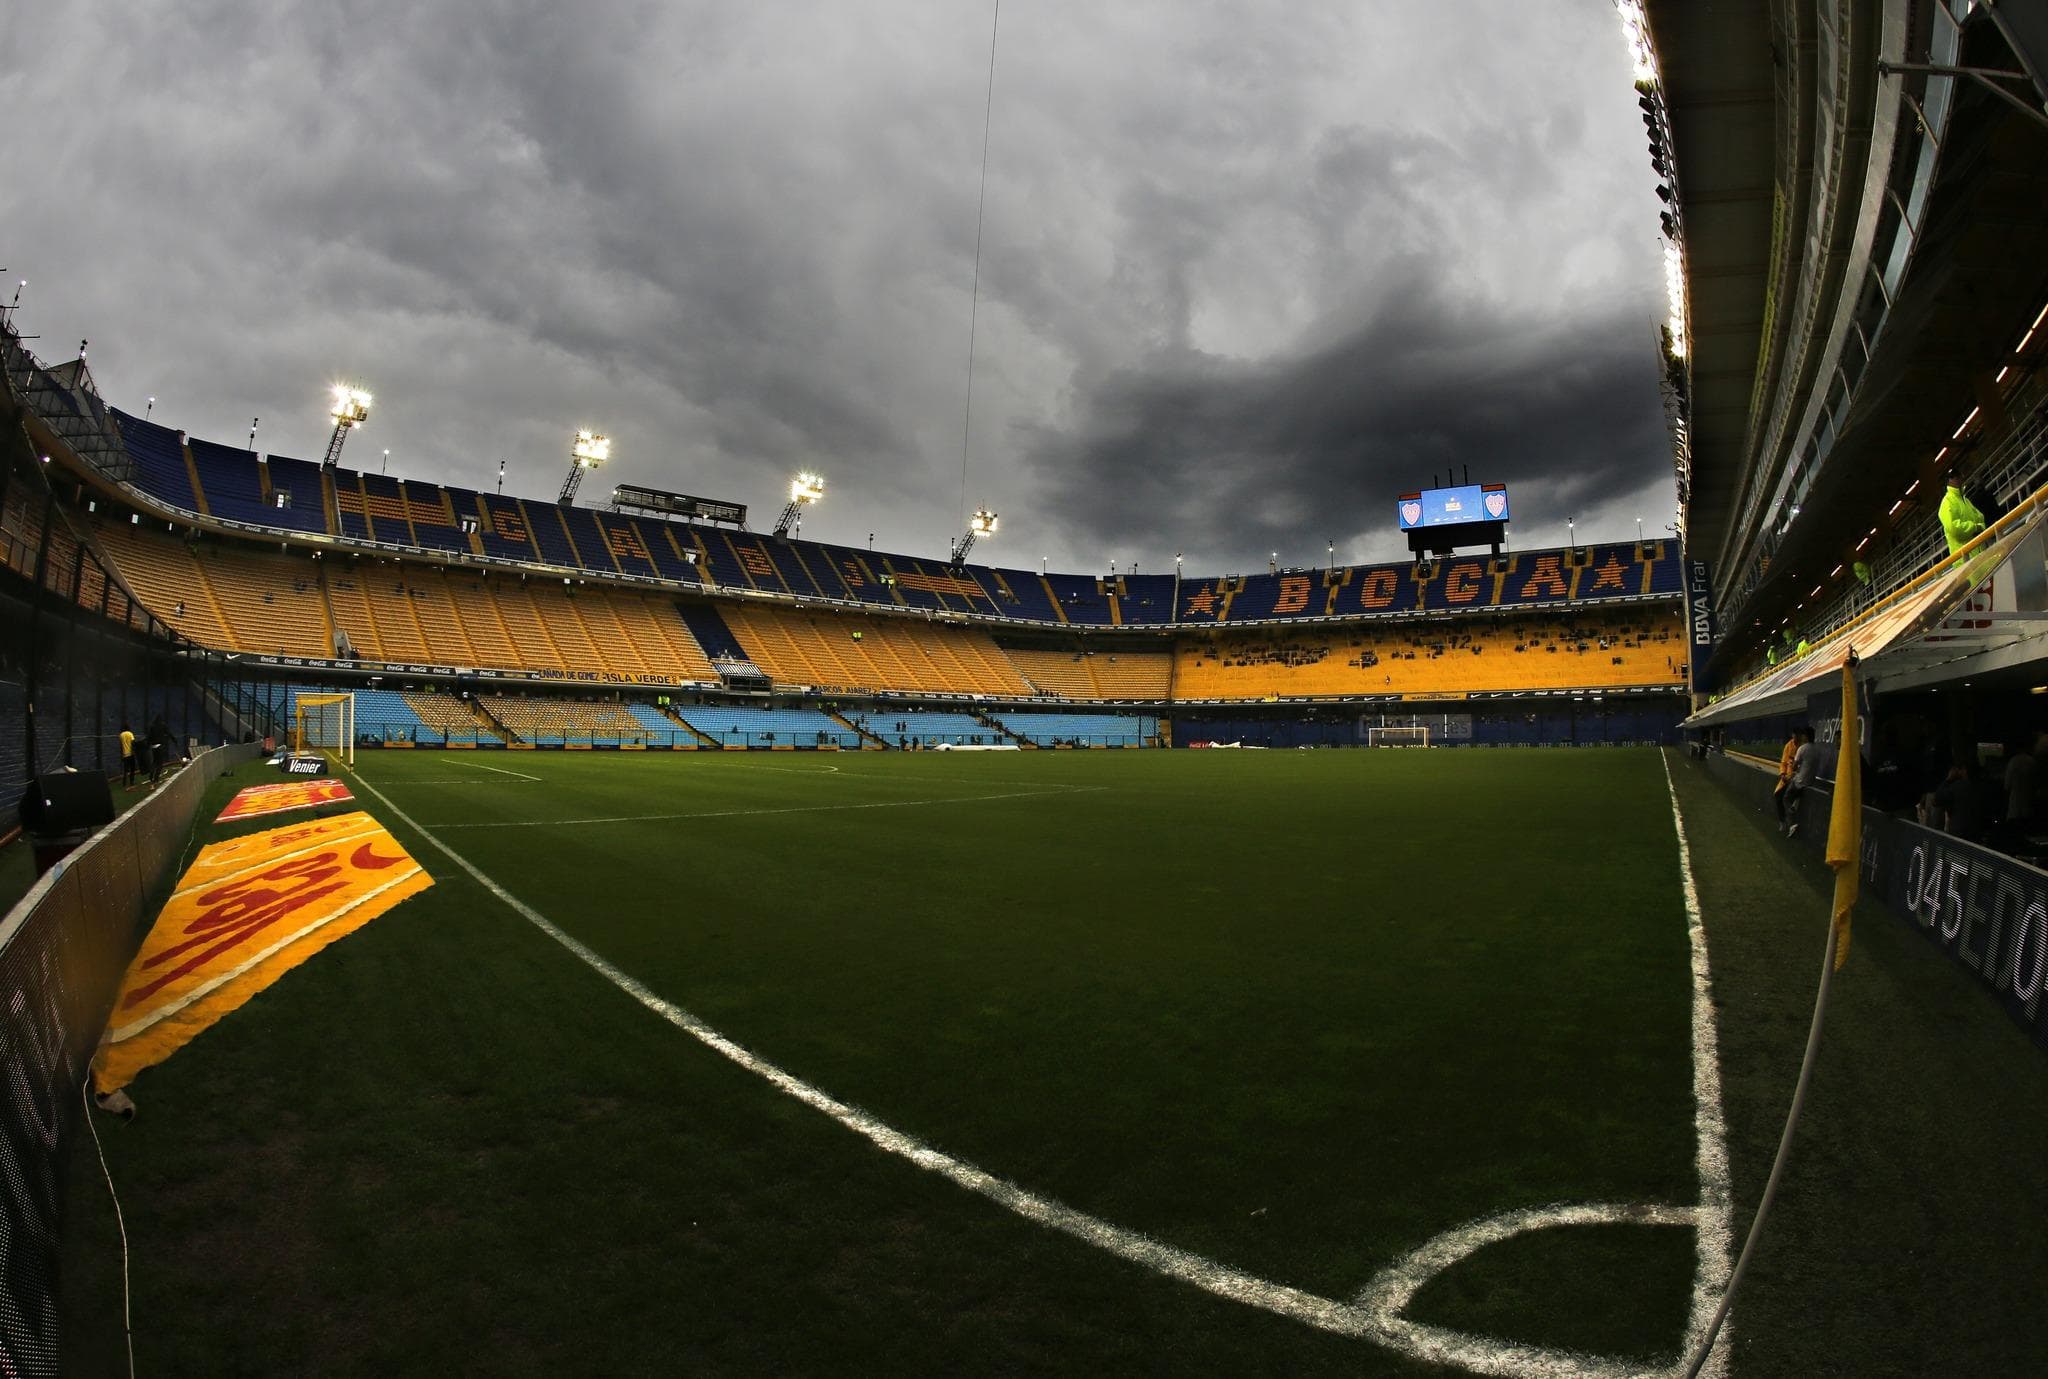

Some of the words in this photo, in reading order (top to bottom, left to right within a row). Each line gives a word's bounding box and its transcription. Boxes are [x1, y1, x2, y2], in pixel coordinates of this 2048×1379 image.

[1694, 595, 1711, 645] BBVA
[635, 675, 671, 684] VERDE
[289, 759, 321, 774] Venier
